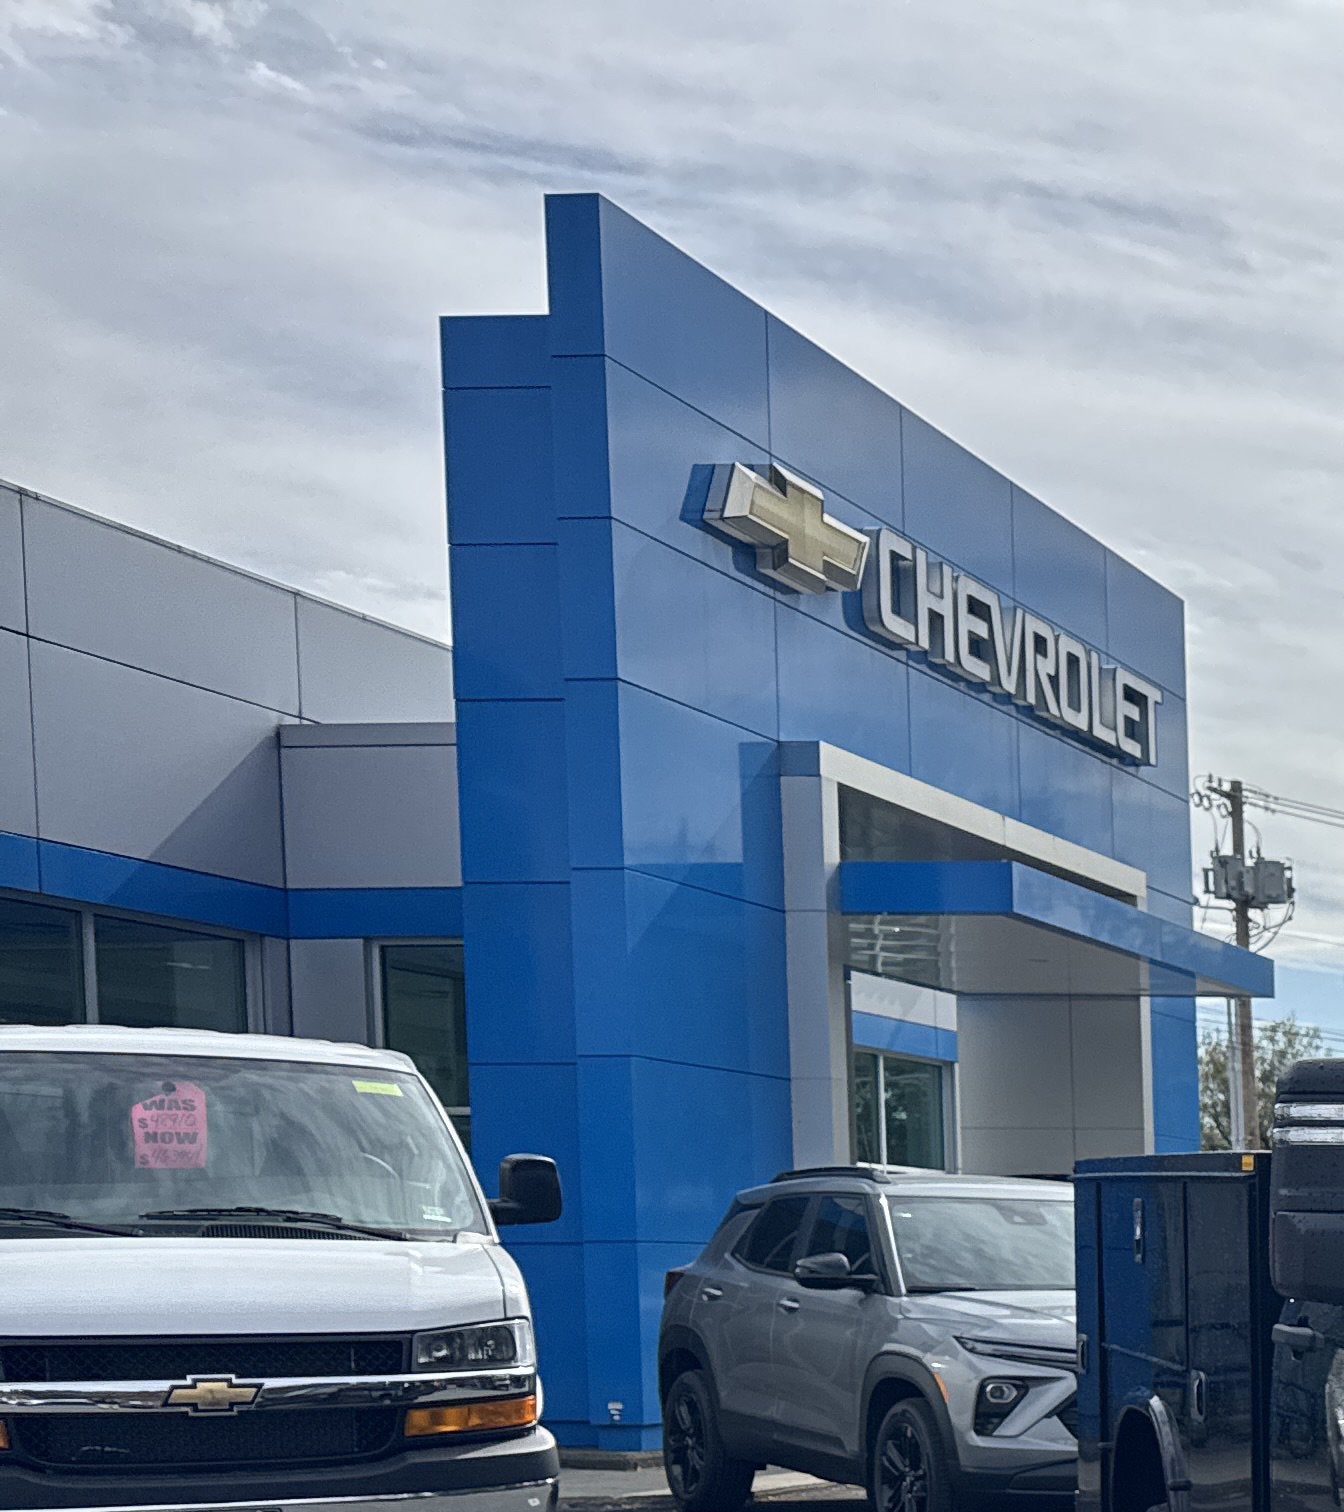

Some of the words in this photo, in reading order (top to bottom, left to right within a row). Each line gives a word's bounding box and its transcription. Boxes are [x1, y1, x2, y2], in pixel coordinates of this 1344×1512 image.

[866, 527, 1163, 767] CHEVROLET
[142, 1098, 196, 1112] WAS
[144, 1131, 199, 1145] NOW
